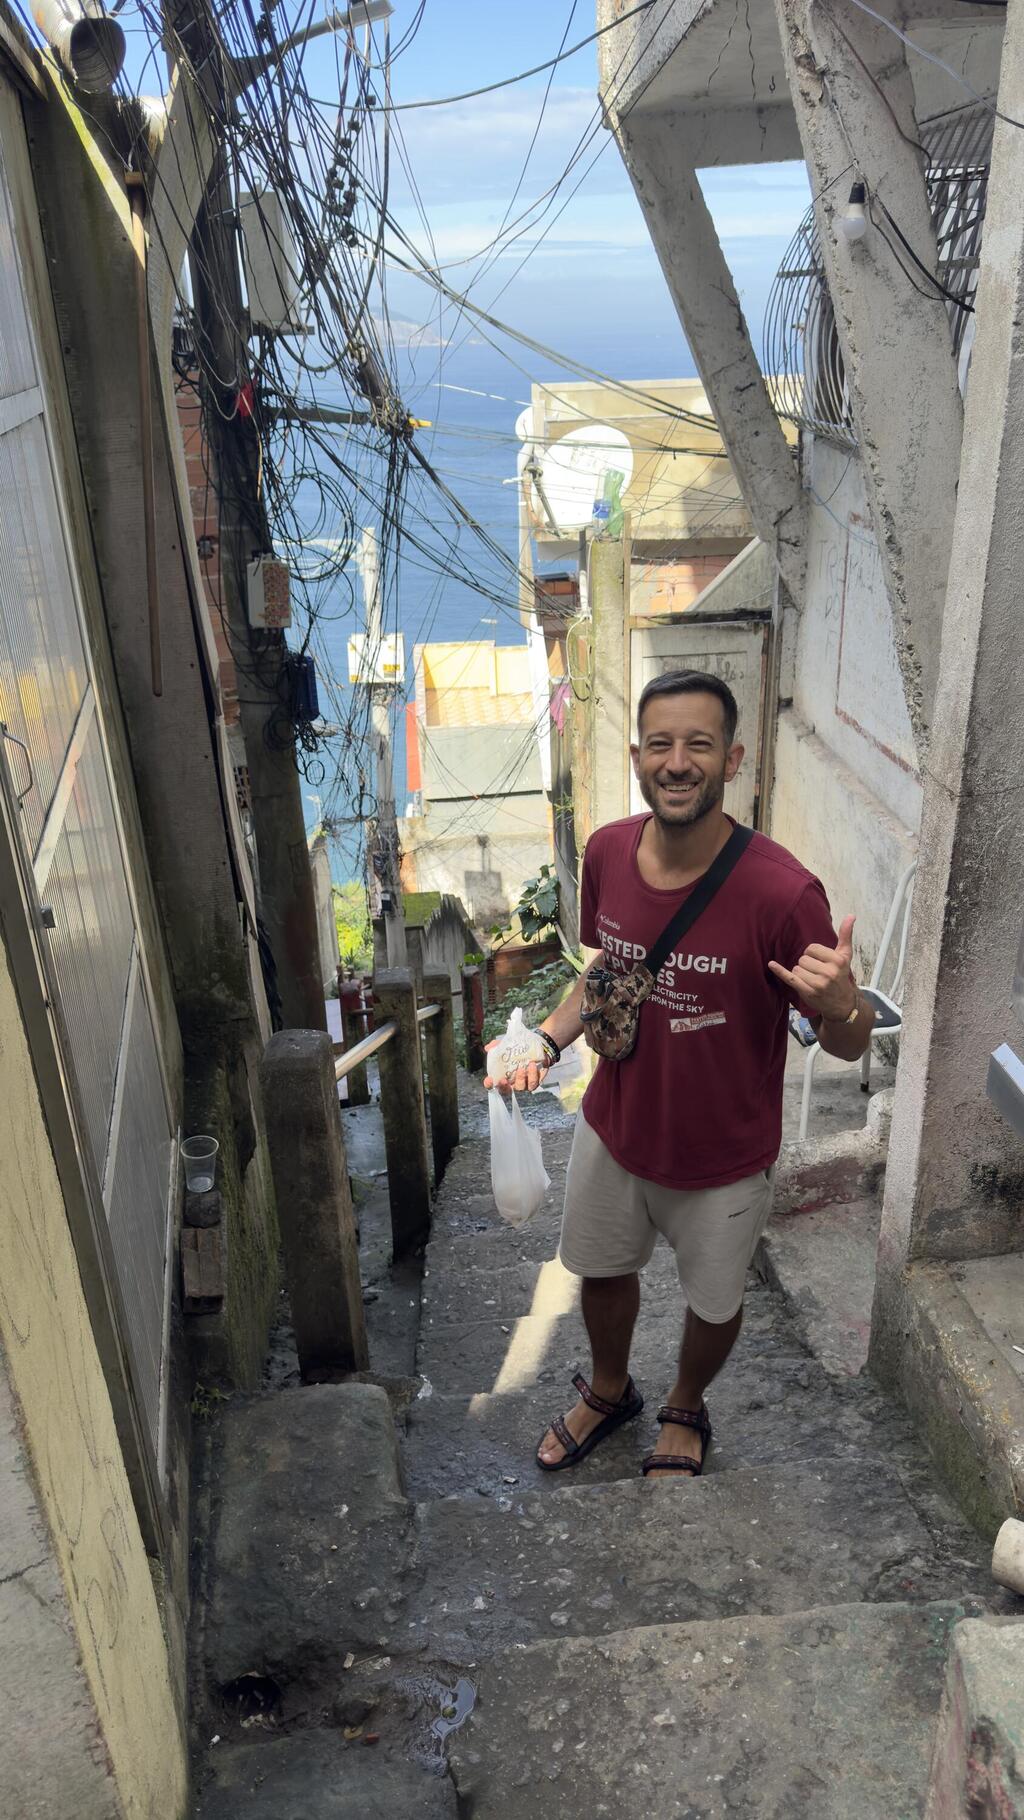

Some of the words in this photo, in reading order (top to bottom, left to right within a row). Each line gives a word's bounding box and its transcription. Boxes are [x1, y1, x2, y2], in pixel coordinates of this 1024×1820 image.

[597, 928, 647, 960] TESTED
[664, 952, 727, 974] OUGH
[653, 984, 698, 1001] LECTRICITY
[668, 1001, 684, 1011] THE
[686, 1005, 704, 1013] SKY
